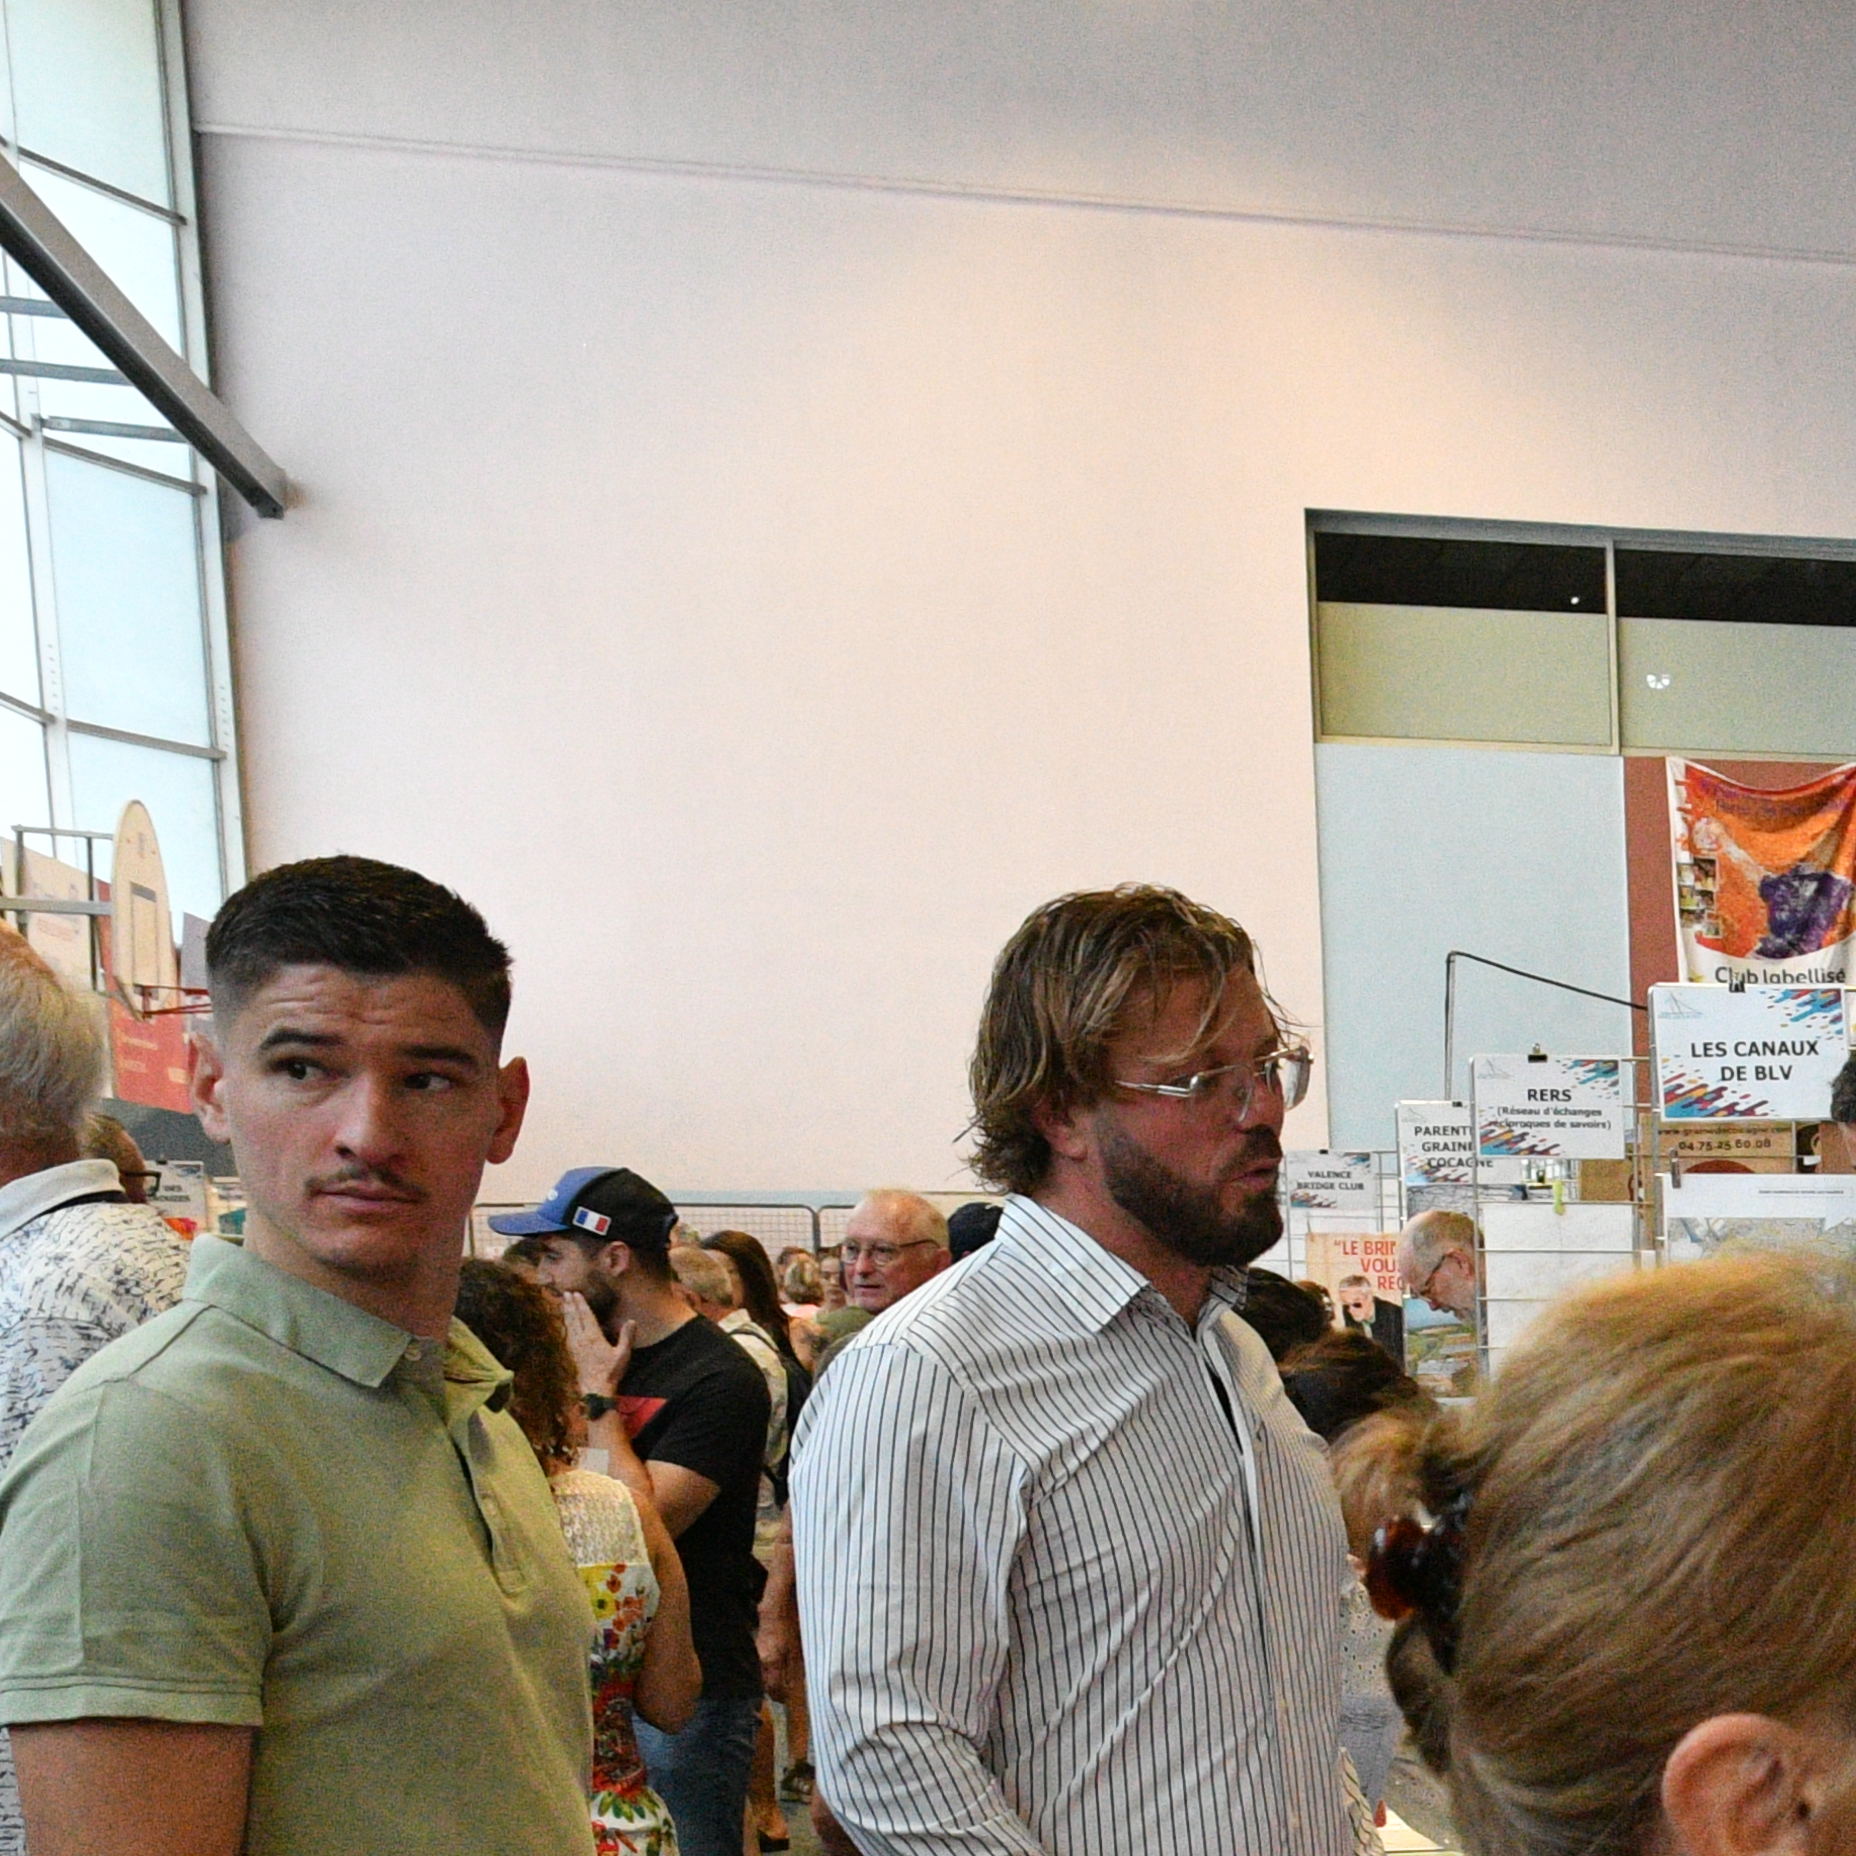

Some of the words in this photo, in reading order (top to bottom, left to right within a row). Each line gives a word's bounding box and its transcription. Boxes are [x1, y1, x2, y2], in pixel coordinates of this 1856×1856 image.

[1763, 966, 1846, 984] labellisé
[1691, 1042, 1727, 1058] LES
[1734, 1040, 1819, 1057] CANAUX
[1721, 1066, 1747, 1081] DE
[1755, 1065, 1793, 1081] BLV
[1527, 1089, 1572, 1102] RERS
[1497, 1106, 1540, 1117] (Réseau
[1553, 1120, 1567, 1129] de
[1569, 1120, 1612, 1130] savoirs)
[1428, 1157, 1494, 1168] COCAGNE
[1307, 1170, 1352, 1179] VALENCE
[1296, 1182, 1335, 1191] BRIDGE
[1338, 1182, 1364, 1191] CLUB
[1360, 1258, 1401, 1273] VOU
